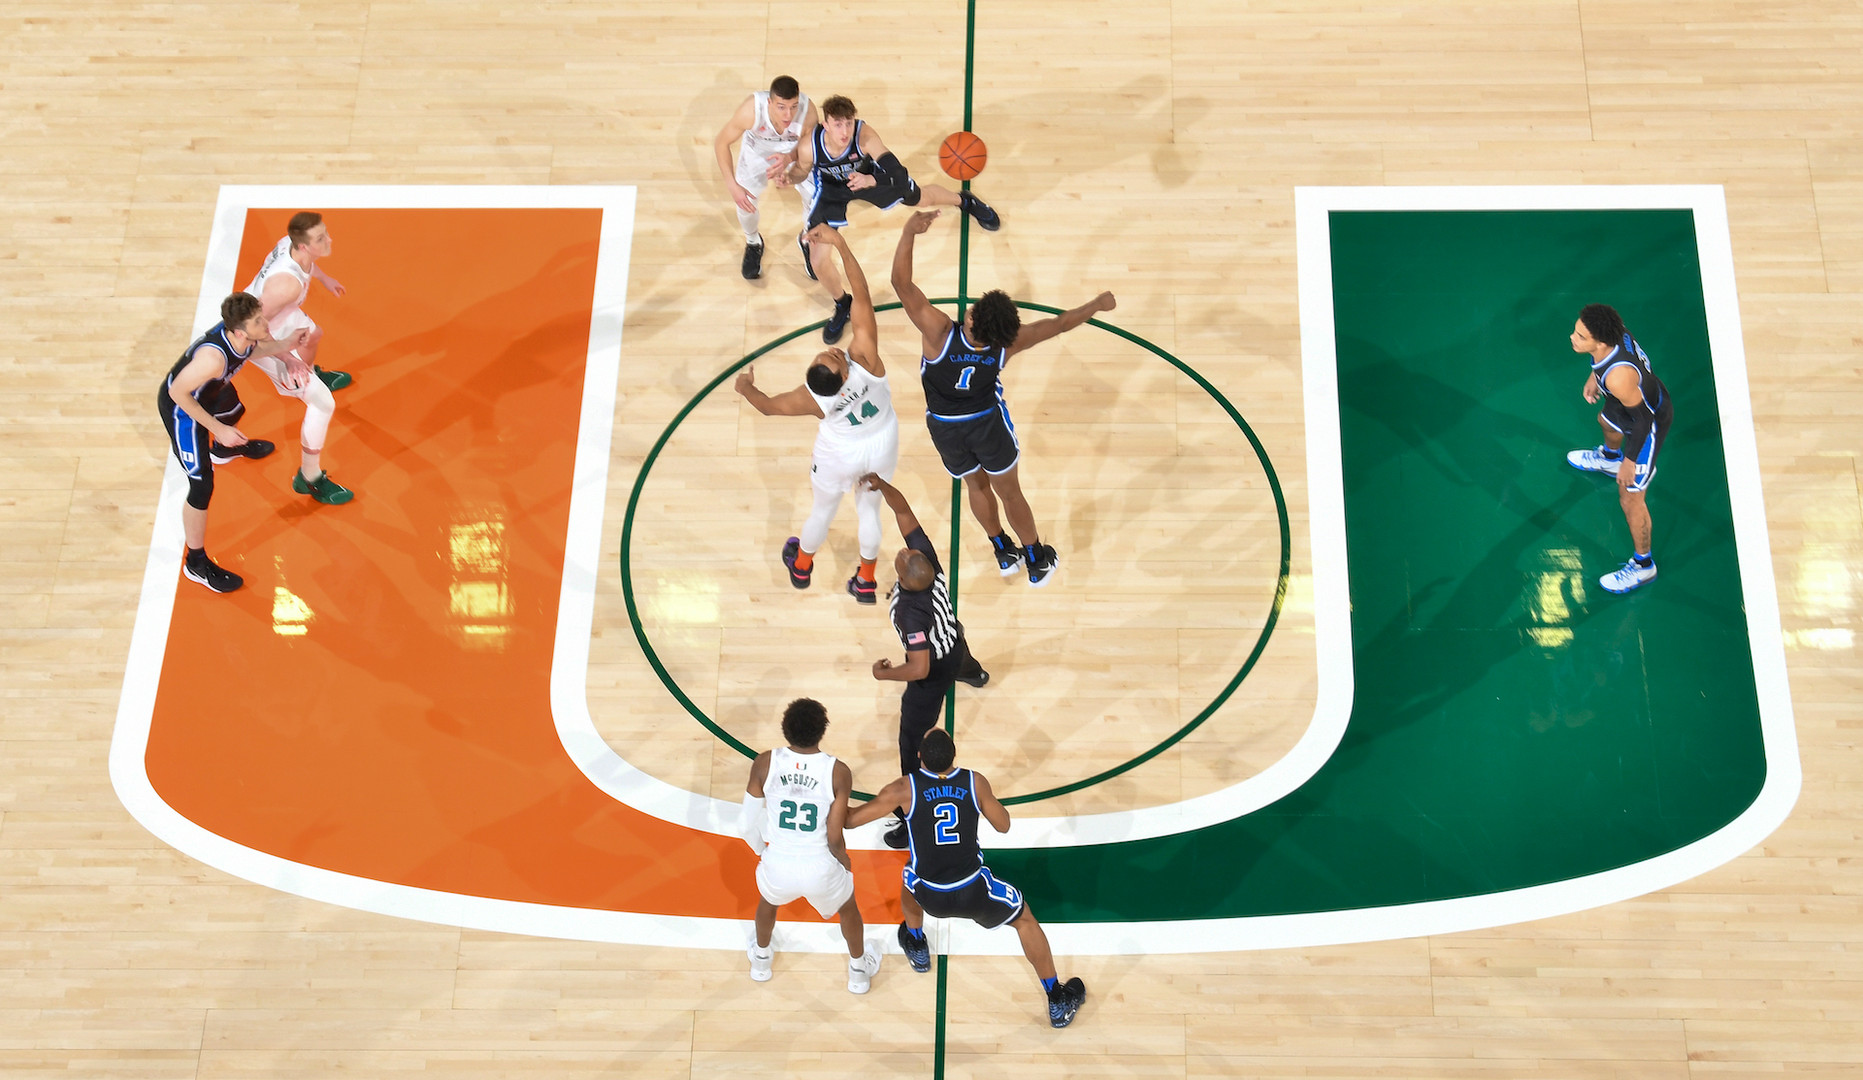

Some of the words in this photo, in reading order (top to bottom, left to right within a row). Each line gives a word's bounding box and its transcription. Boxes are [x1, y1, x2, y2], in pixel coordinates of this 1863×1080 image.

[949, 353, 983, 363] CAREY
[954, 365, 976, 391] 1
[845, 399, 880, 426] 14
[109, 185, 1801, 955] U
[923, 785, 968, 802] STANLEY
[779, 799, 818, 833] 23
[933, 802, 961, 846] 2
